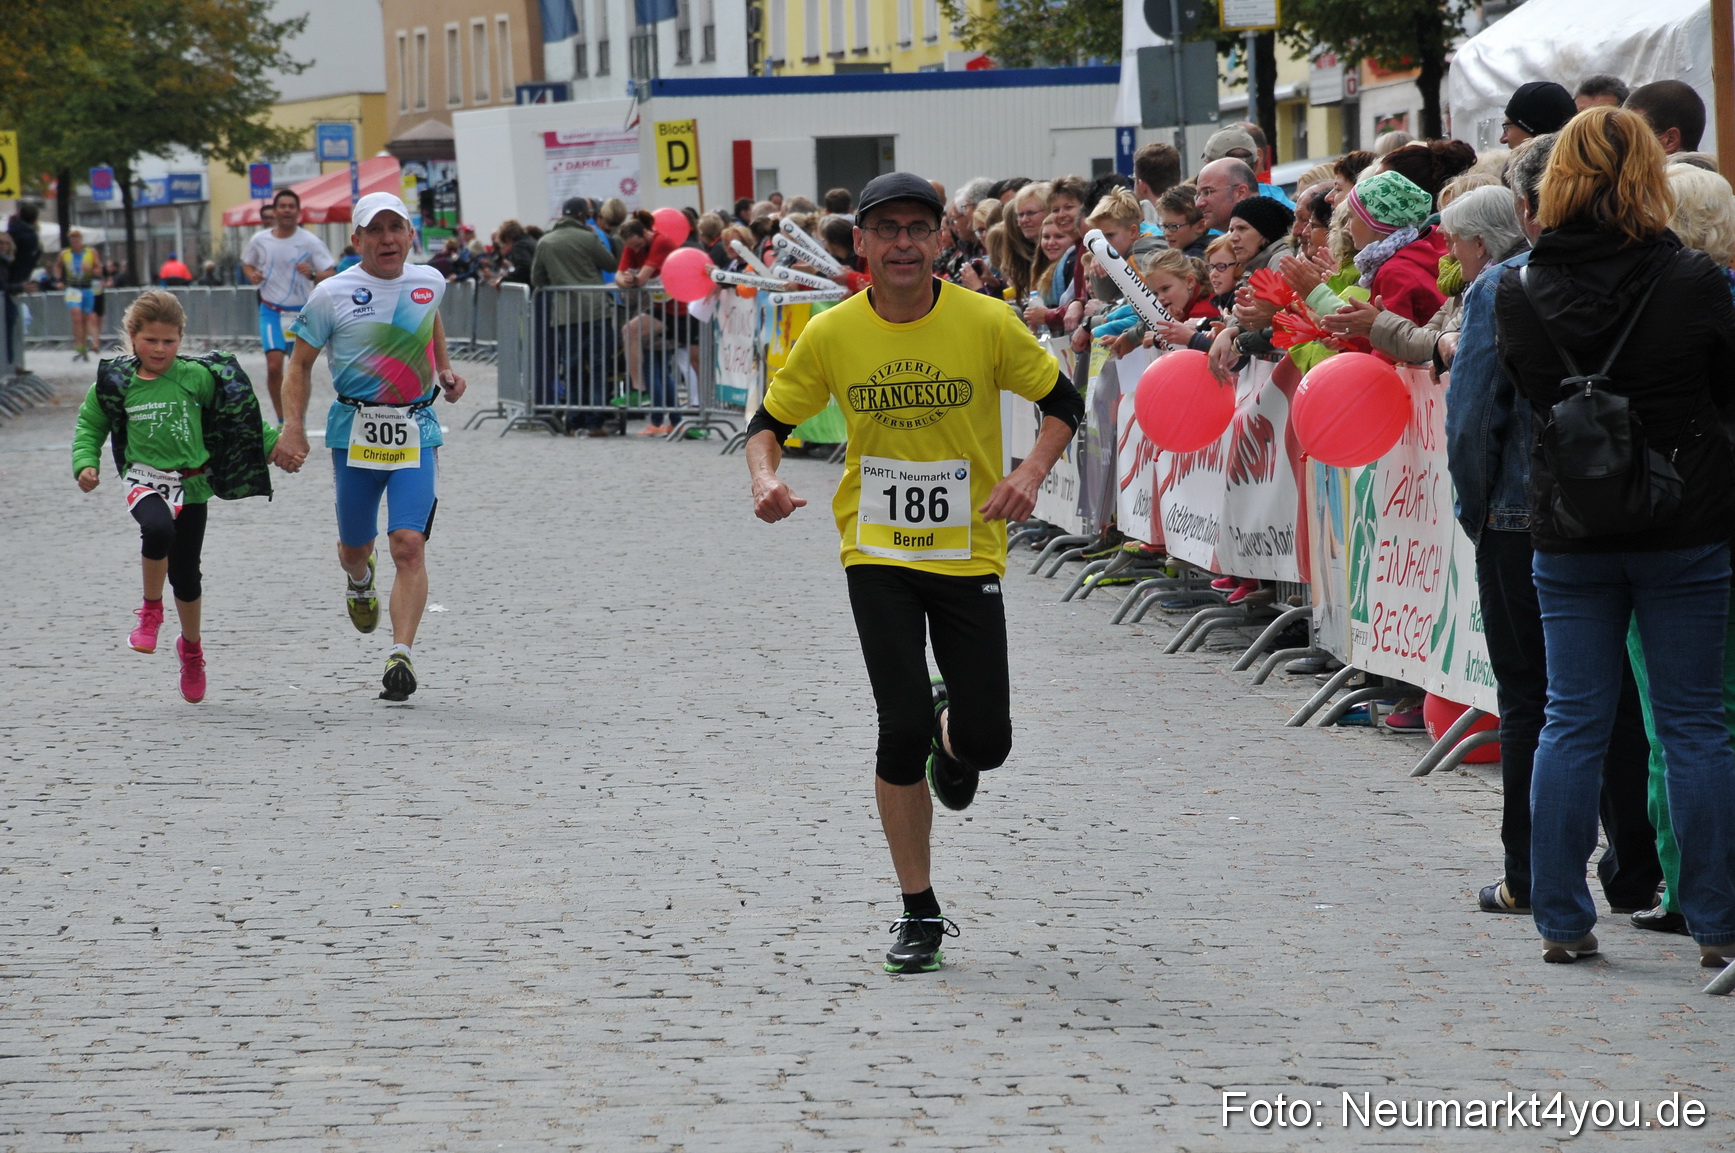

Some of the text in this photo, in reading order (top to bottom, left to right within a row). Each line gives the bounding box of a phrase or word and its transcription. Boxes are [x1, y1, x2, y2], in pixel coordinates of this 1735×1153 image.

[659, 123, 692, 136] Block
[667, 140, 690, 172] D
[790, 246, 812, 264] BMW
[1124, 265, 1153, 298] BMW
[352, 306, 375, 315] PARTL
[870, 361, 940, 386] PIZZERIA
[859, 382, 958, 409] FRANCESCO
[874, 408, 944, 428] HERSBRUCK
[364, 422, 407, 446] 305
[363, 448, 406, 463] Christoph
[863, 466, 951, 482] PARTL Neumarkt
[883, 484, 949, 523] 186
[893, 531, 934, 547] Bernd
[1371, 601, 1433, 663] BESSER
